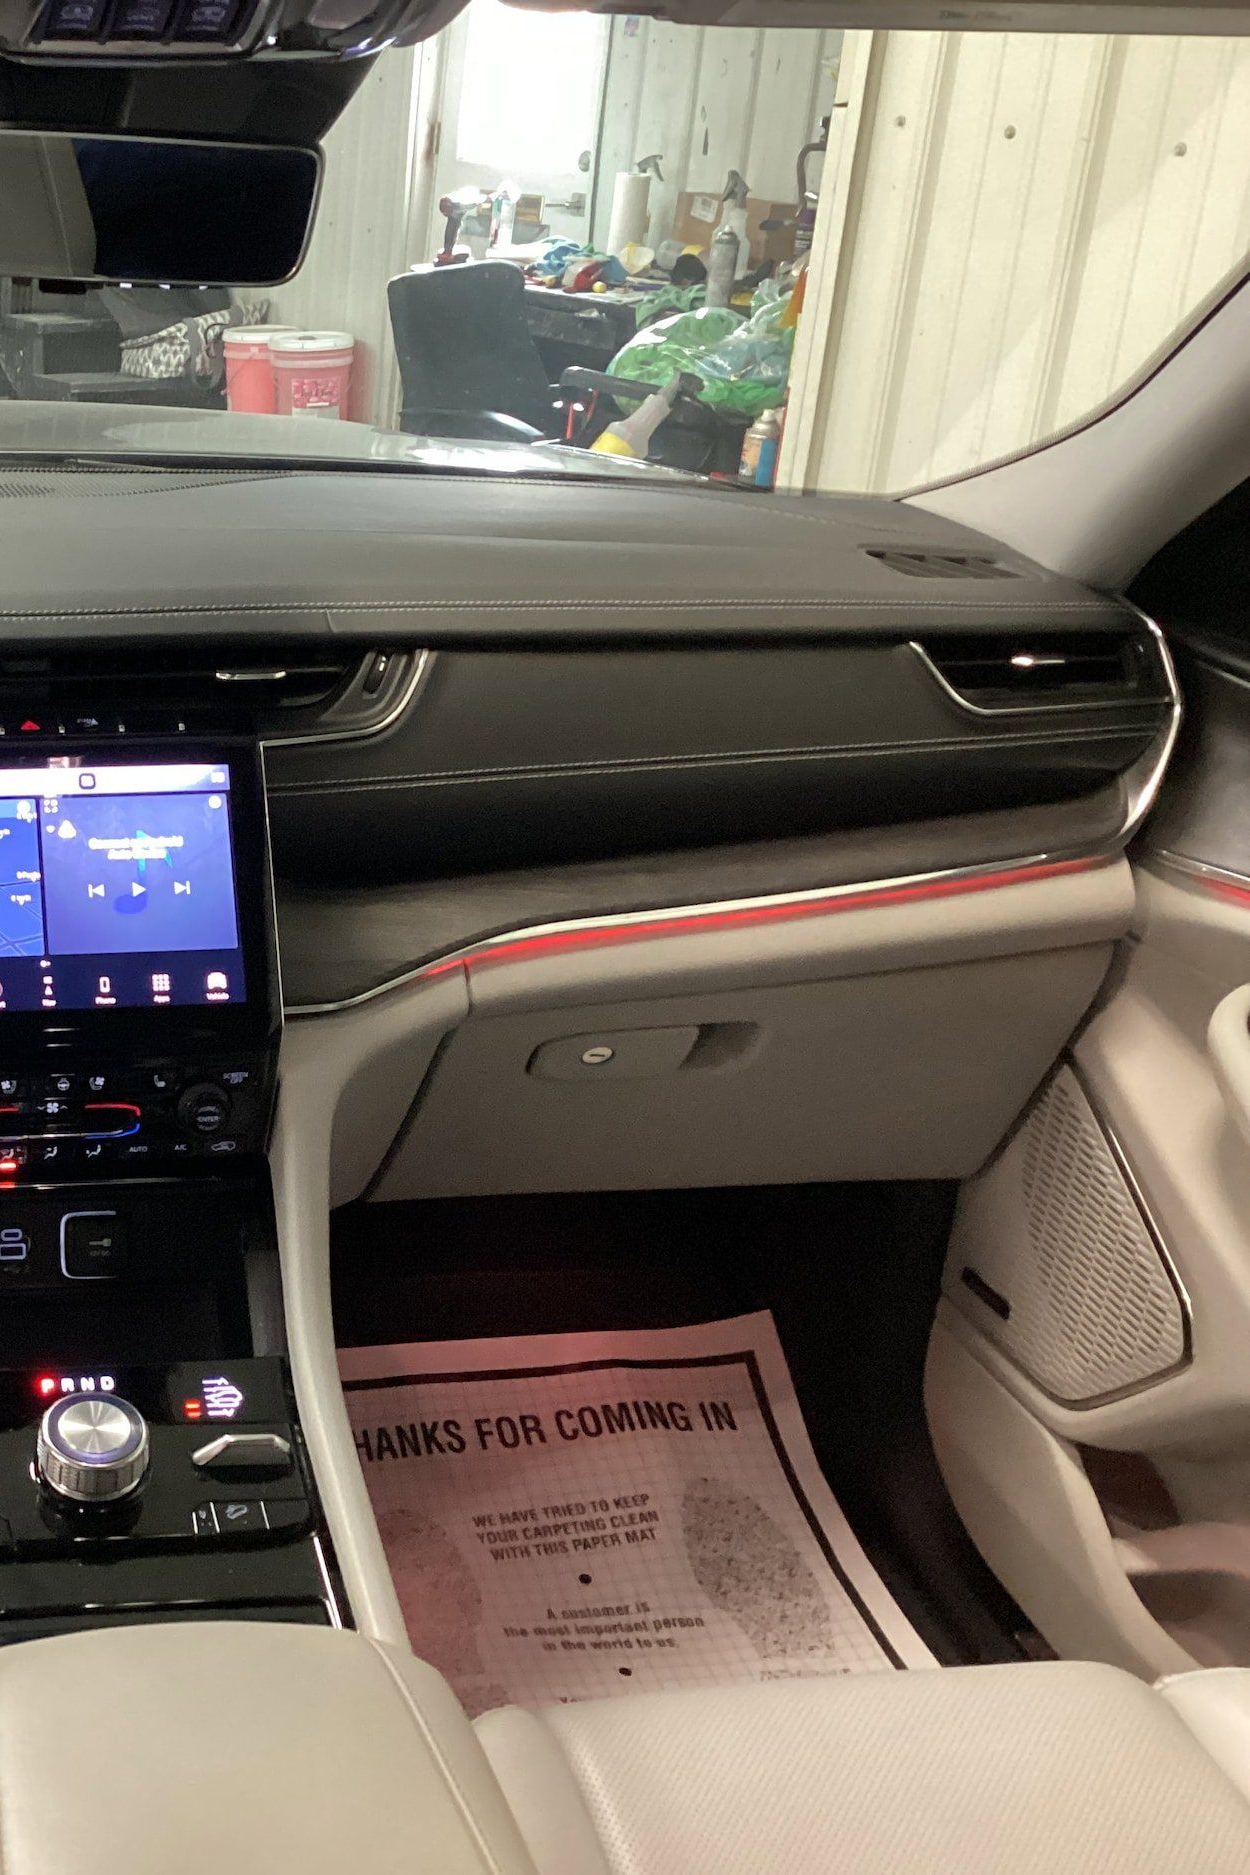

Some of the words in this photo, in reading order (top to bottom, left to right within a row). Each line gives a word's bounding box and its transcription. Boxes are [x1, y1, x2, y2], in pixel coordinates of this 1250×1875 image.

[41, 1379, 54, 1393] P
[61, 1378, 74, 1392] R
[80, 1377, 95, 1391] N
[100, 1376, 114, 1391] D
[352, 1419, 466, 1462] HANKS
[474, 1414, 547, 1450] FOR
[554, 1400, 693, 1440] COMING
[699, 1401, 738, 1431] IN
[472, 1515, 497, 1528] WE
[500, 1509, 539, 1524] HAVE
[543, 1502, 586, 1519] TRIED
[589, 1499, 609, 1513] TO
[613, 1493, 649, 1509] KEEP
[476, 1530, 518, 1545] YOUR
[522, 1516, 606, 1540] CARPETING
[610, 1510, 660, 1528] CLEAN
[490, 1545, 530, 1561] WITH
[535, 1540, 569, 1557] THIS
[572, 1533, 621, 1552] PAPER
[625, 1527, 657, 1544] MAT
[546, 1608, 557, 1620] A
[561, 1604, 630, 1619] customer
[503, 1626, 528, 1637] the
[533, 1624, 570, 1636] most
[574, 1621, 649, 1636] important
[652, 1616, 705, 1633] person
[542, 1640, 557, 1651] in
[561, 1640, 586, 1650] the
[590, 1638, 634, 1650] world
[636, 1638, 652, 1649] to
